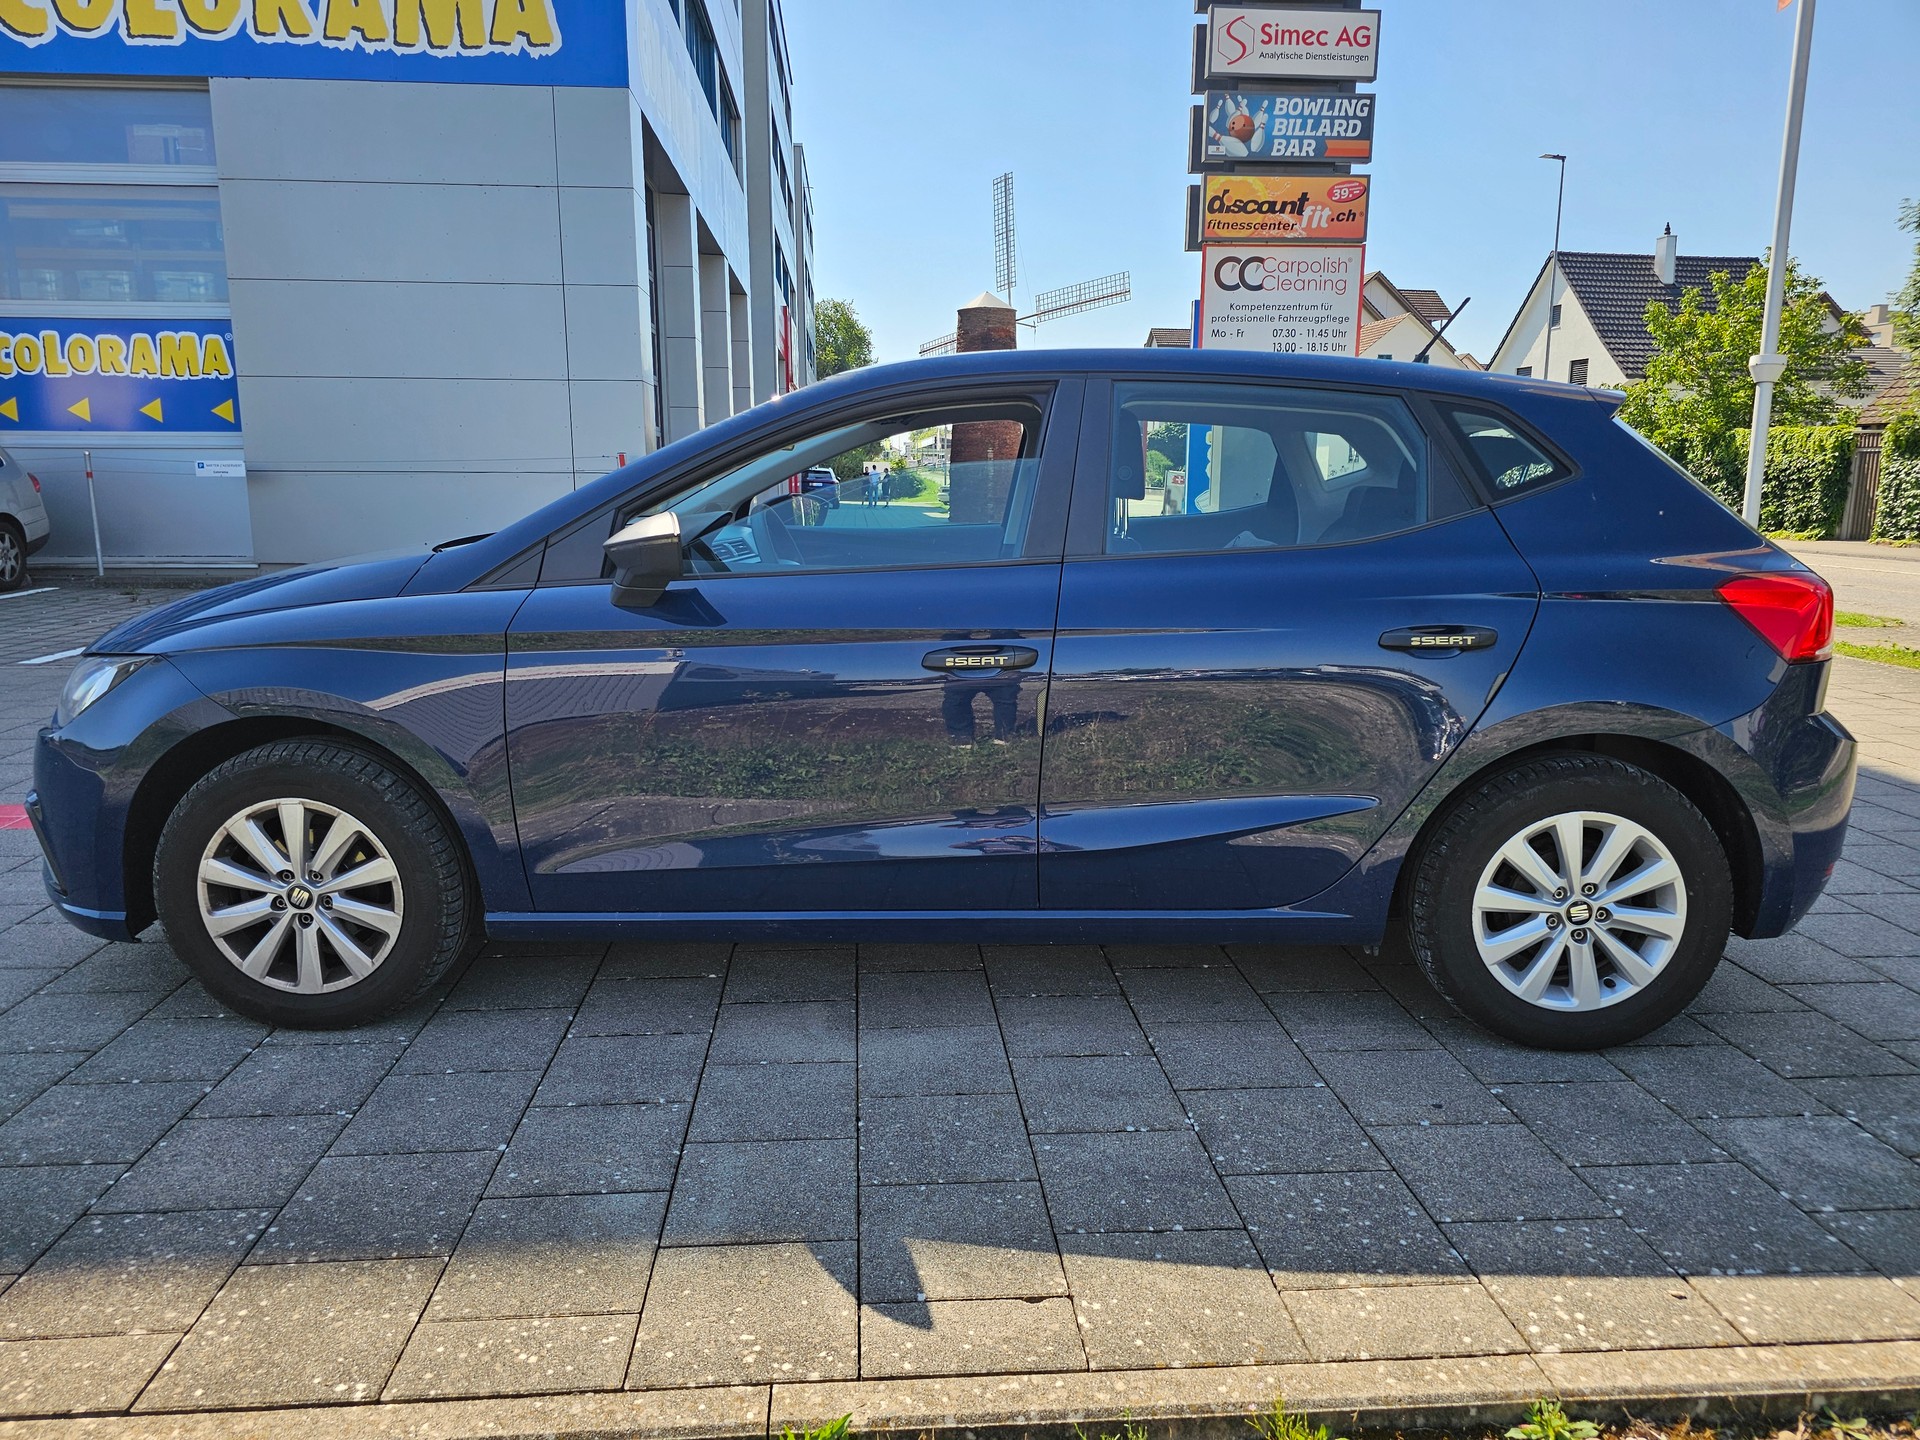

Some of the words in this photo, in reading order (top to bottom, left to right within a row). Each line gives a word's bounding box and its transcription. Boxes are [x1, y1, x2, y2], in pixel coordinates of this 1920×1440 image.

[1260, 22, 1329, 47] Simec
[1335, 25, 1371, 48] AG
[1258, 51, 1304, 61] Analytische
[1305, 52, 1369, 63] Dienstleistungen
[1273, 97, 1371, 117] BOWLING
[1272, 118, 1362, 137] BILLARD
[1271, 138, 1316, 157] BAR
[1207, 219, 1298, 231] fitnesscenter
[1262, 256, 1348, 277] Carpolish
[1261, 274, 1347, 296] Cleaning
[1229, 302, 1319, 313] Kompetenzzentrum
[1320, 302, 1333, 311] für
[1211, 314, 1276, 324] professionelle
[1278, 314, 1350, 324] Fahrzeugpflege
[1211, 329, 1227, 338] Mo
[1236, 329, 1245, 338] Fr
[1272, 328, 1297, 338] 07.30
[1306, 329, 1329, 338] 11.45
[1331, 329, 1347, 338] Uhr
[1272, 342, 1297, 352] 13.00
[1306, 342, 1329, 352] 18.15
[1331, 342, 1347, 352] Uhr
[1421, 636, 1476, 645] SEAT
[954, 656, 1008, 666] SEAT
